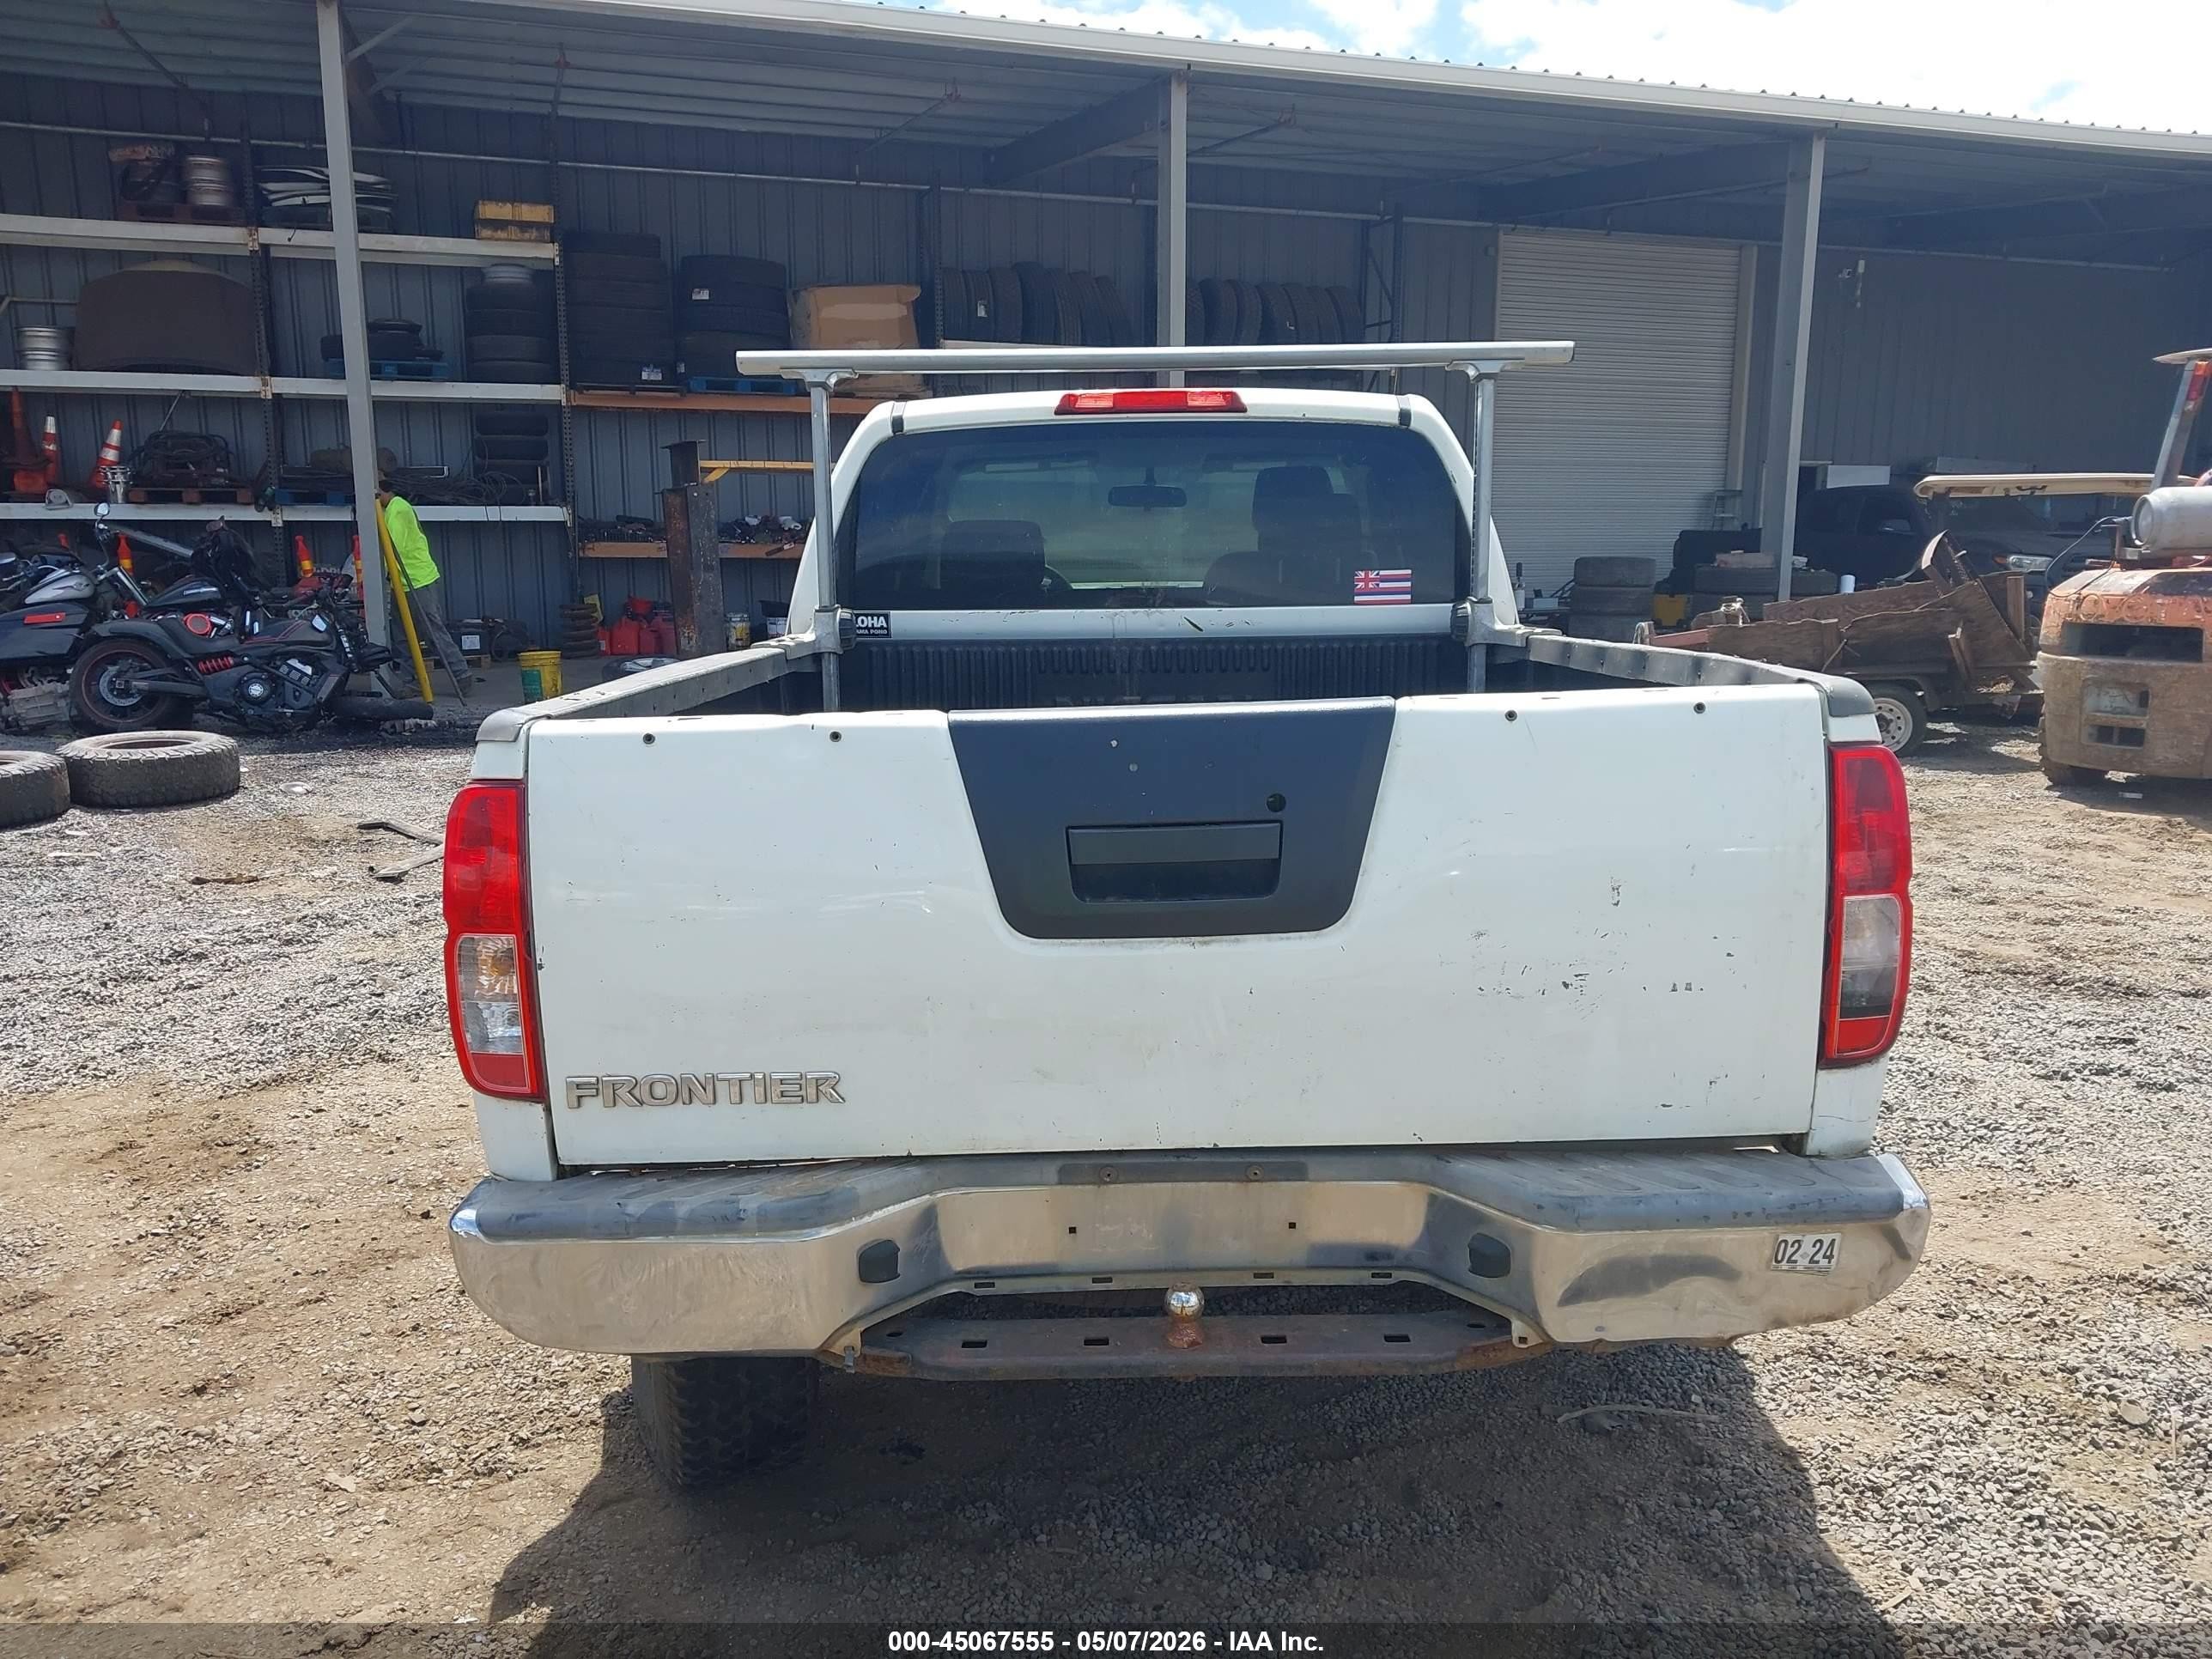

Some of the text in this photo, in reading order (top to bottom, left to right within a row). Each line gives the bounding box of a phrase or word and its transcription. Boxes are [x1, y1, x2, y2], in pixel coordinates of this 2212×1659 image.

[855, 616, 888, 628] OHA
[565, 1072, 845, 1109] FRONTIER
[1774, 1238, 1836, 1264] 02 24
